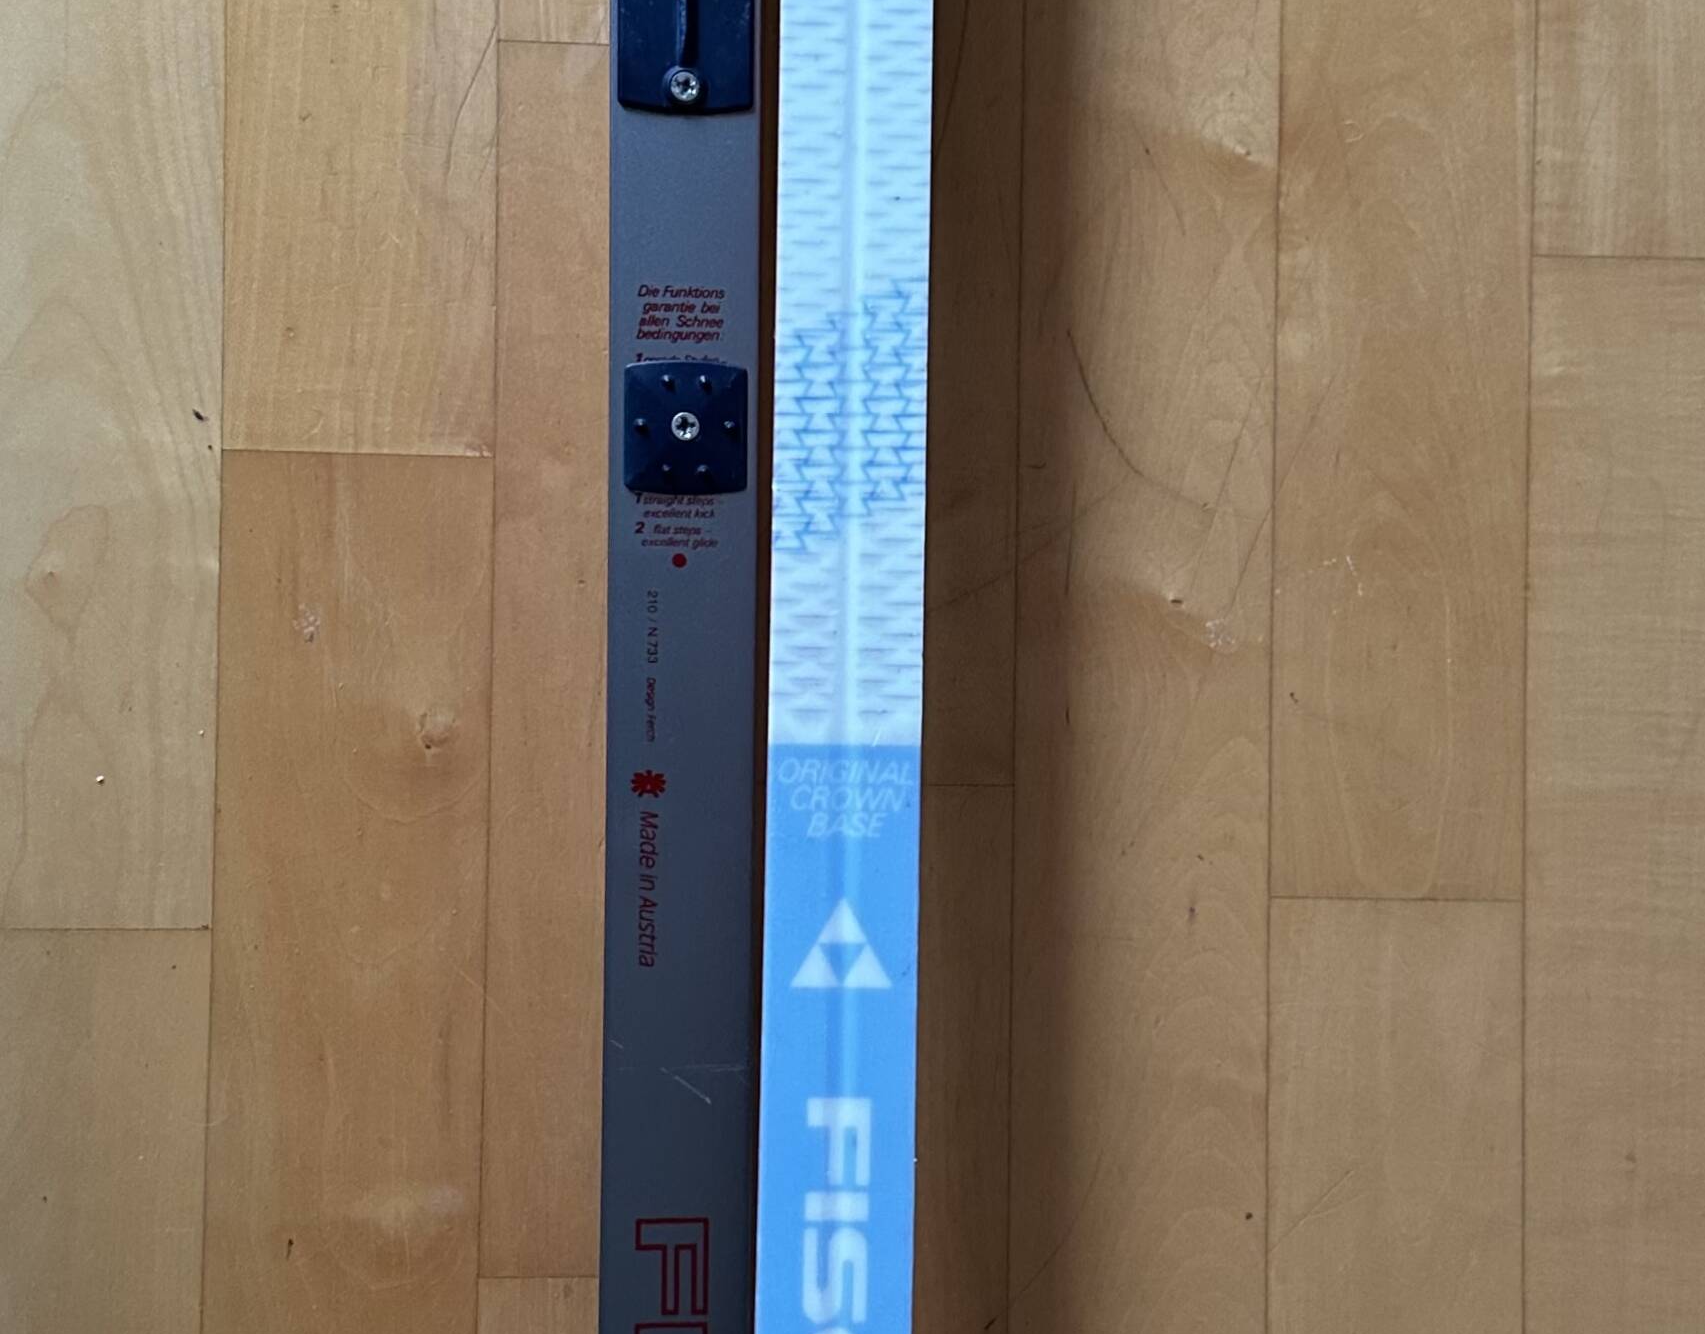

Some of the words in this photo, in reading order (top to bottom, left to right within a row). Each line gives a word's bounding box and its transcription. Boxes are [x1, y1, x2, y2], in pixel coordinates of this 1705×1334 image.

[637, 284, 660, 298] Die
[642, 301, 697, 315] garantie
[701, 301, 720, 314] bei
[638, 315, 670, 327] allen
[676, 315, 724, 329] Schnee
[643, 495, 684, 507] straight
[686, 495, 714, 507] steps
[643, 509, 692, 519] excellent
[634, 521, 645, 534] 2
[653, 524, 671, 535] flat
[672, 526, 702, 536] steps
[641, 538, 690, 547] excellent
[648, 590, 658, 613] 210
[648, 626, 658, 637] N
[778, 757, 914, 787] ORIGINAL
[790, 783, 908, 812] CROWN
[806, 811, 889, 839] BASE
[638, 811, 659, 868] Made
[638, 874, 659, 891] in
[638, 896, 659, 967] Austria
